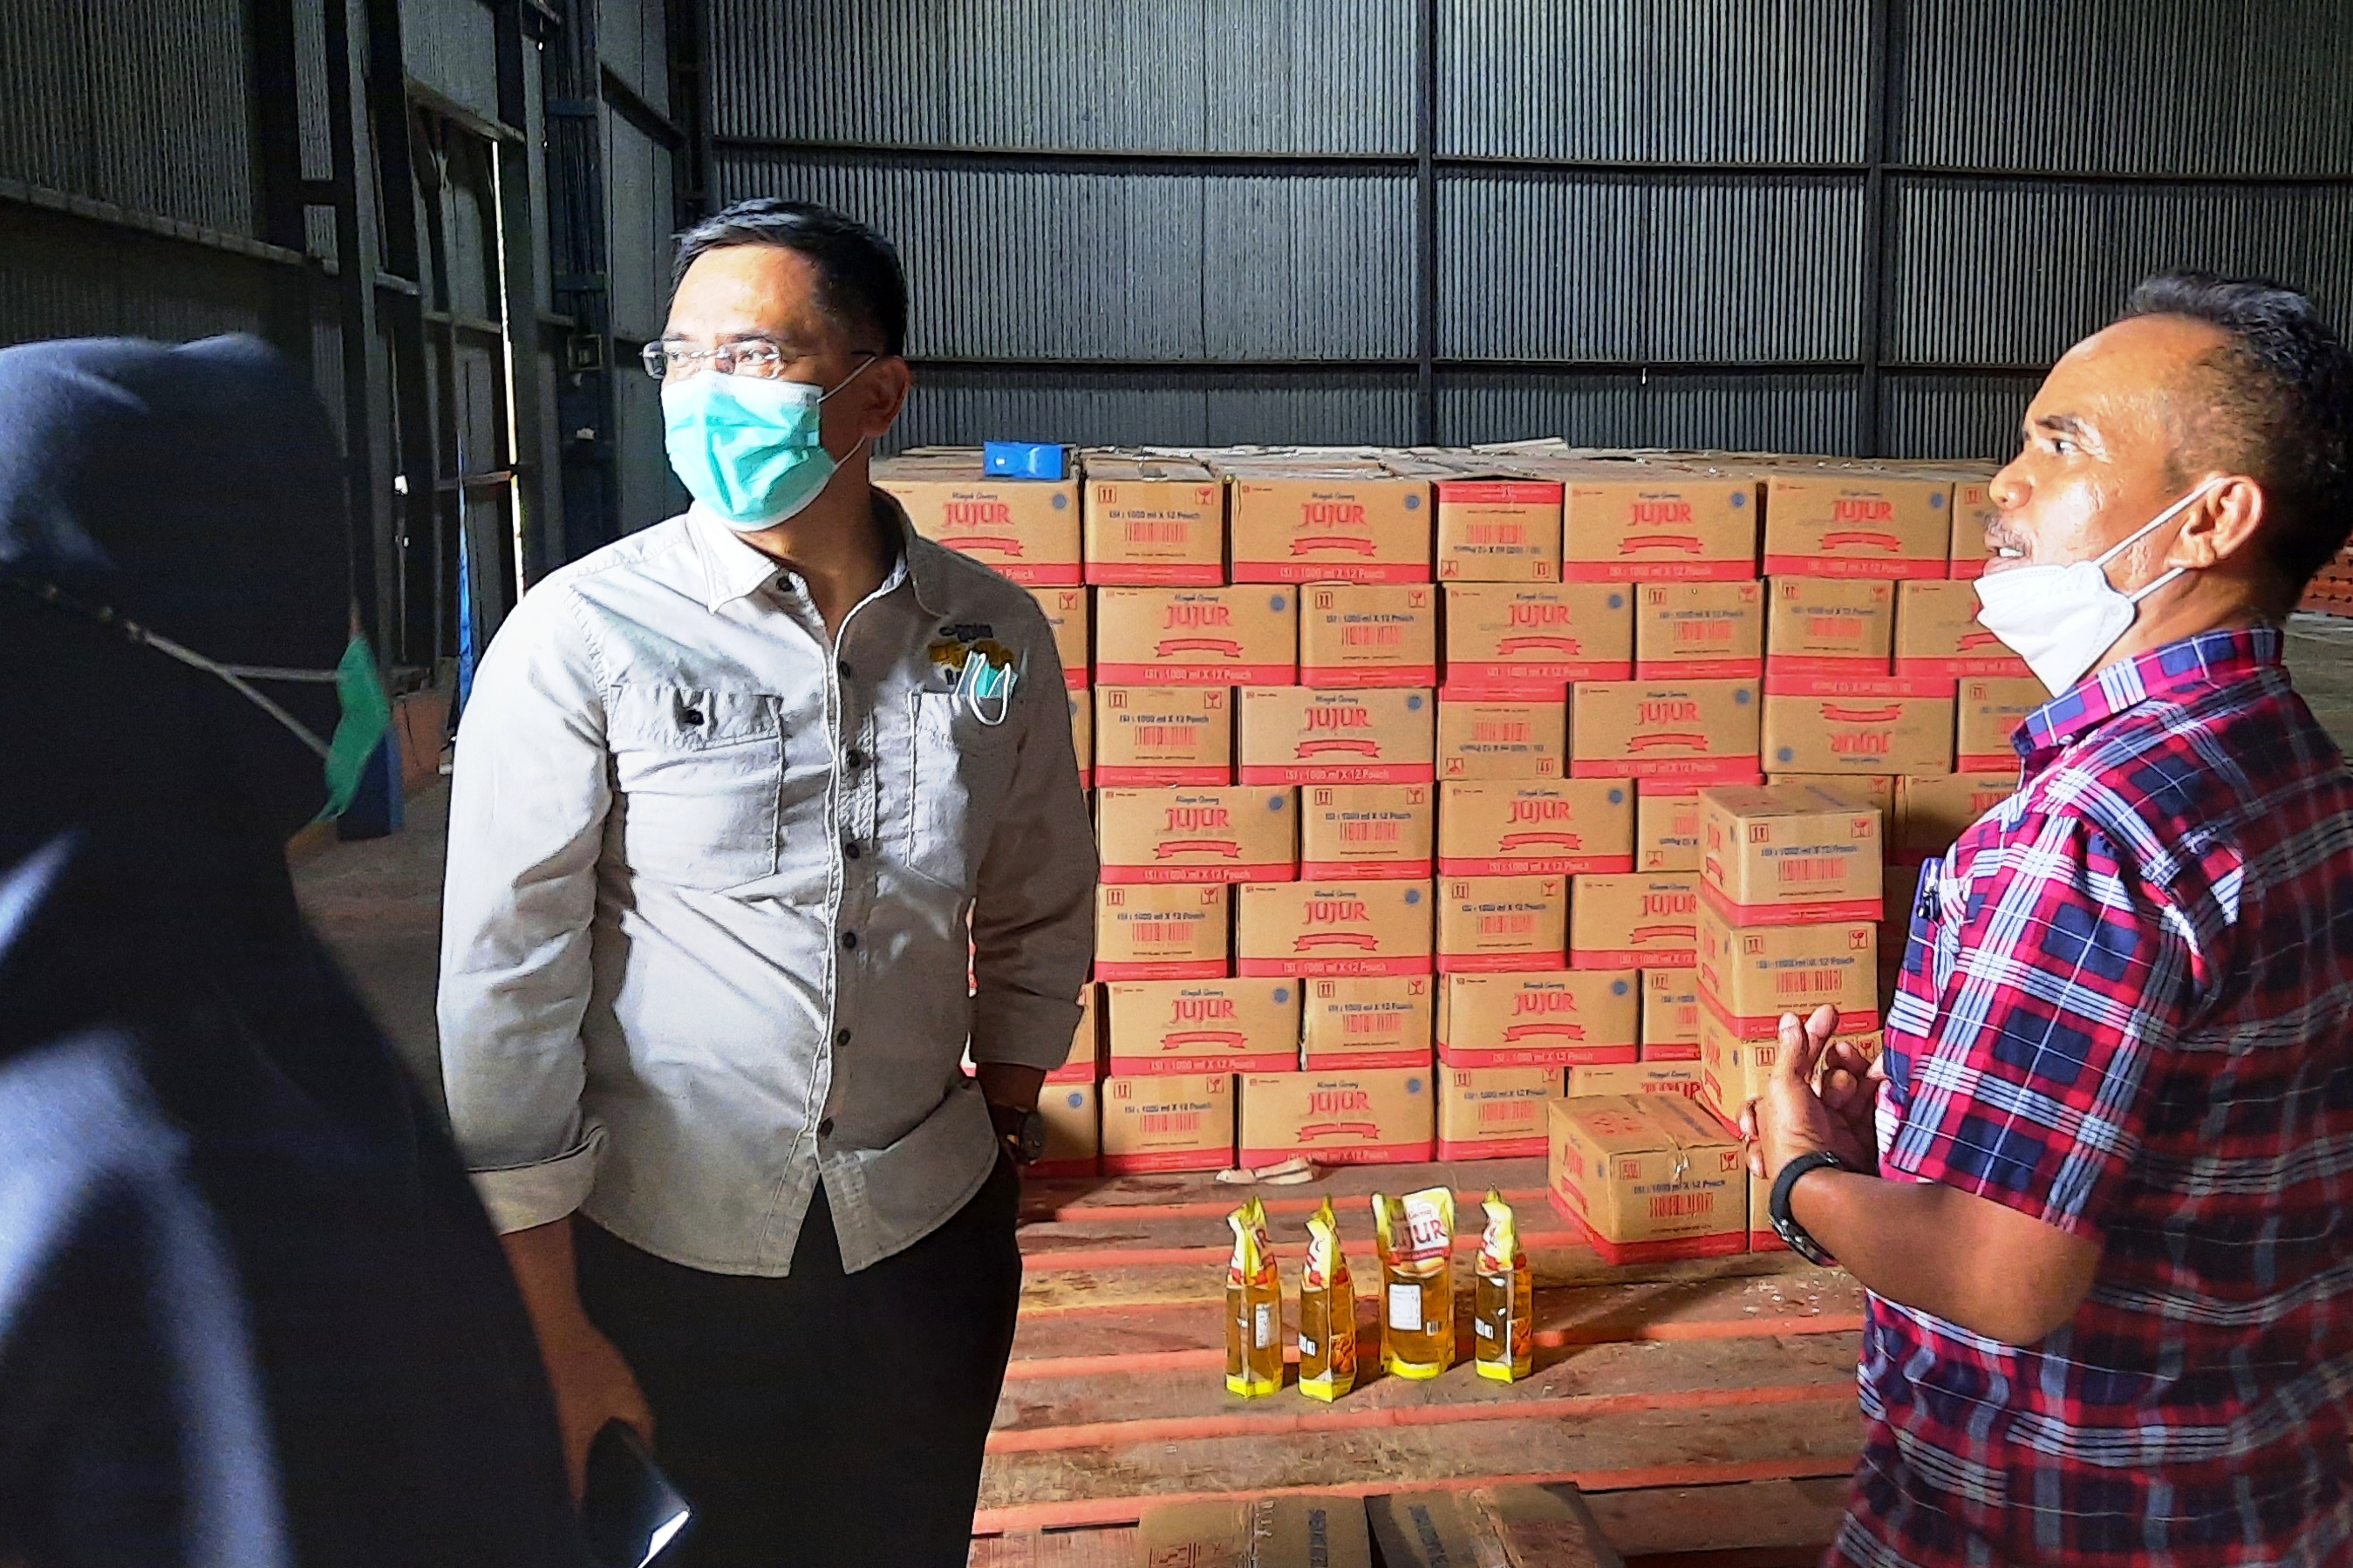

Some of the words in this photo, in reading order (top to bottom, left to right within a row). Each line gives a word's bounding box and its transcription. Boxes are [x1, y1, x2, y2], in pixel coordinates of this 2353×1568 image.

[944, 503, 1014, 527] JUJUR
[1298, 503, 1367, 528] JUJUR
[1628, 503, 1693, 526] JUJUR
[1832, 500, 1893, 522] JUJUR
[1163, 605, 1233, 629] JUJUR
[1509, 604, 1572, 627] JUJUR
[1145, 670, 1157, 679] ISI
[1165, 670, 1186, 679] 1000
[1212, 670, 1222, 679] 12
[1224, 670, 1252, 679] Pouch
[1304, 706, 1372, 731] JUJUR
[1635, 703, 1699, 726] JUJUR
[1164, 808, 1230, 831] JUJUR
[1507, 801, 1573, 824] JUJUR
[1302, 902, 1370, 925] JUJUR
[1170, 1000, 1238, 1023] JUJUR
[1511, 992, 1577, 1016] JUJUR
[1308, 1091, 1374, 1115] JUJUR
